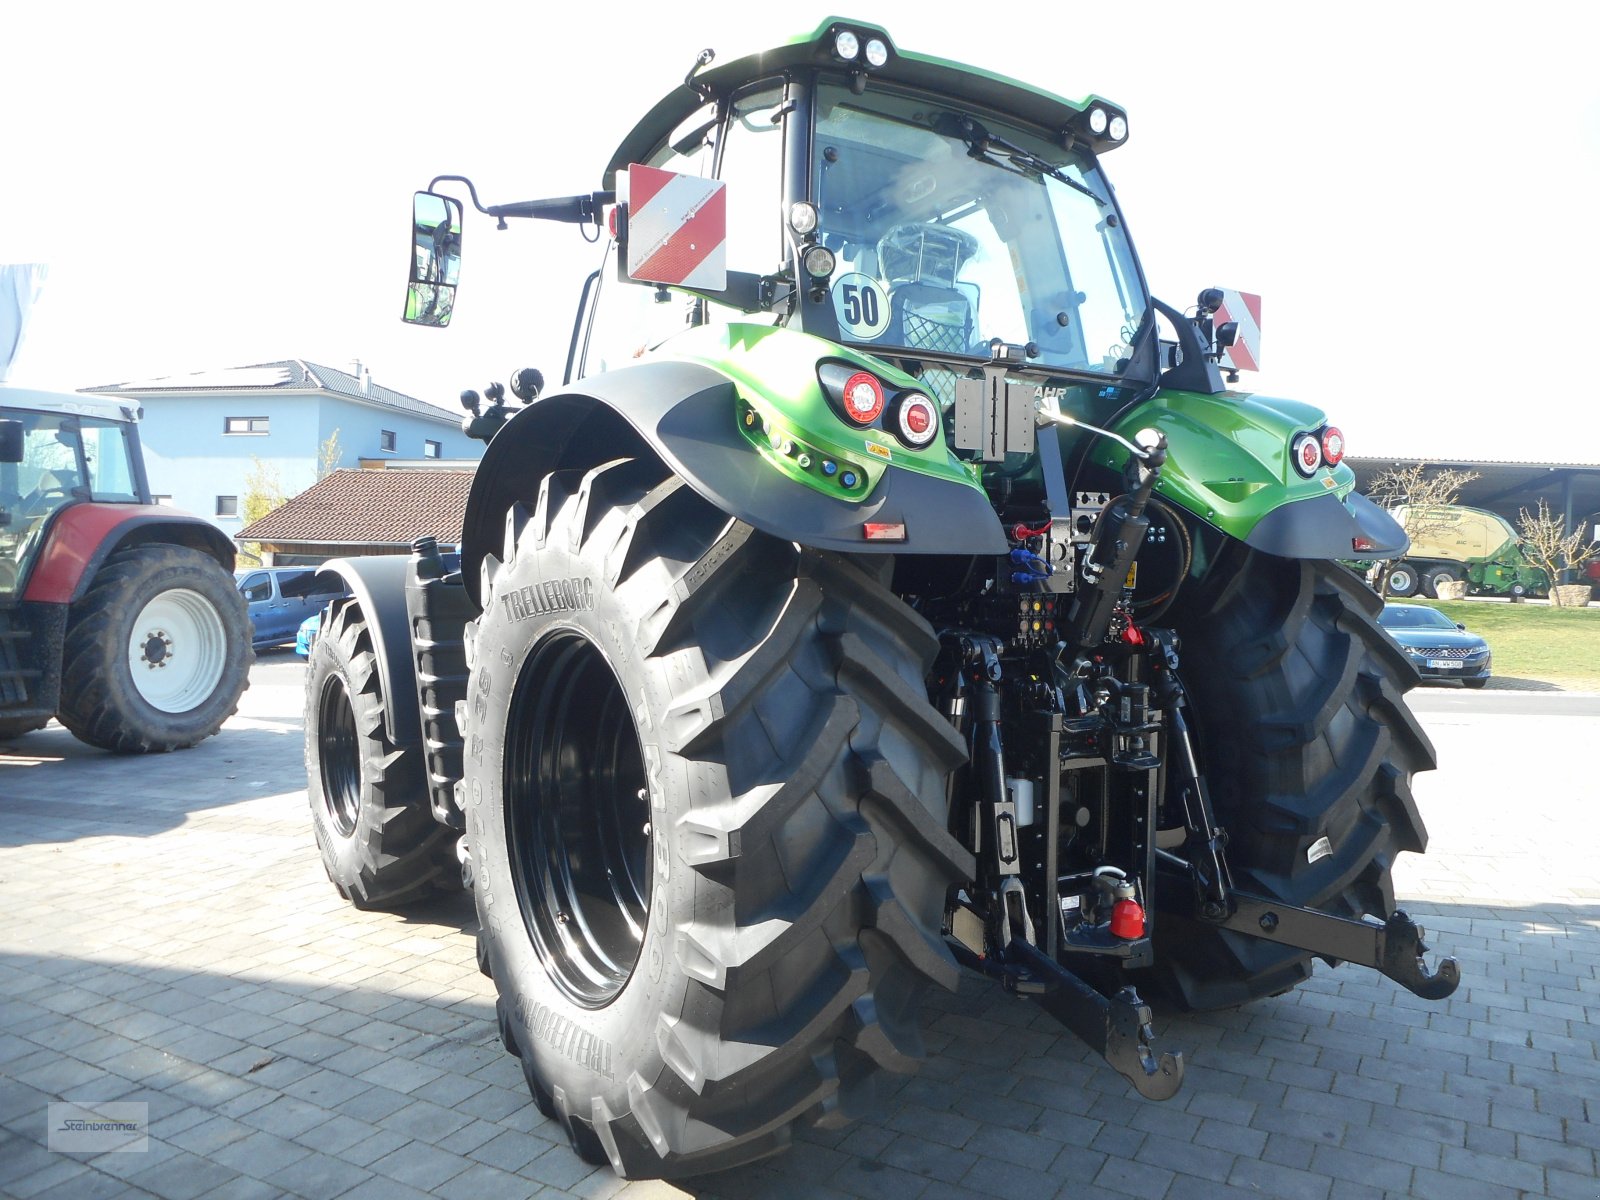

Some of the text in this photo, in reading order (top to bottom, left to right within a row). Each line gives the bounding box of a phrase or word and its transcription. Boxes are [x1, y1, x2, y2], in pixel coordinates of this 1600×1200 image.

[842, 285, 879, 327] 50
[500, 577, 595, 624] TRELLEBORG
[514, 992, 616, 1083] TRELLEBORG
